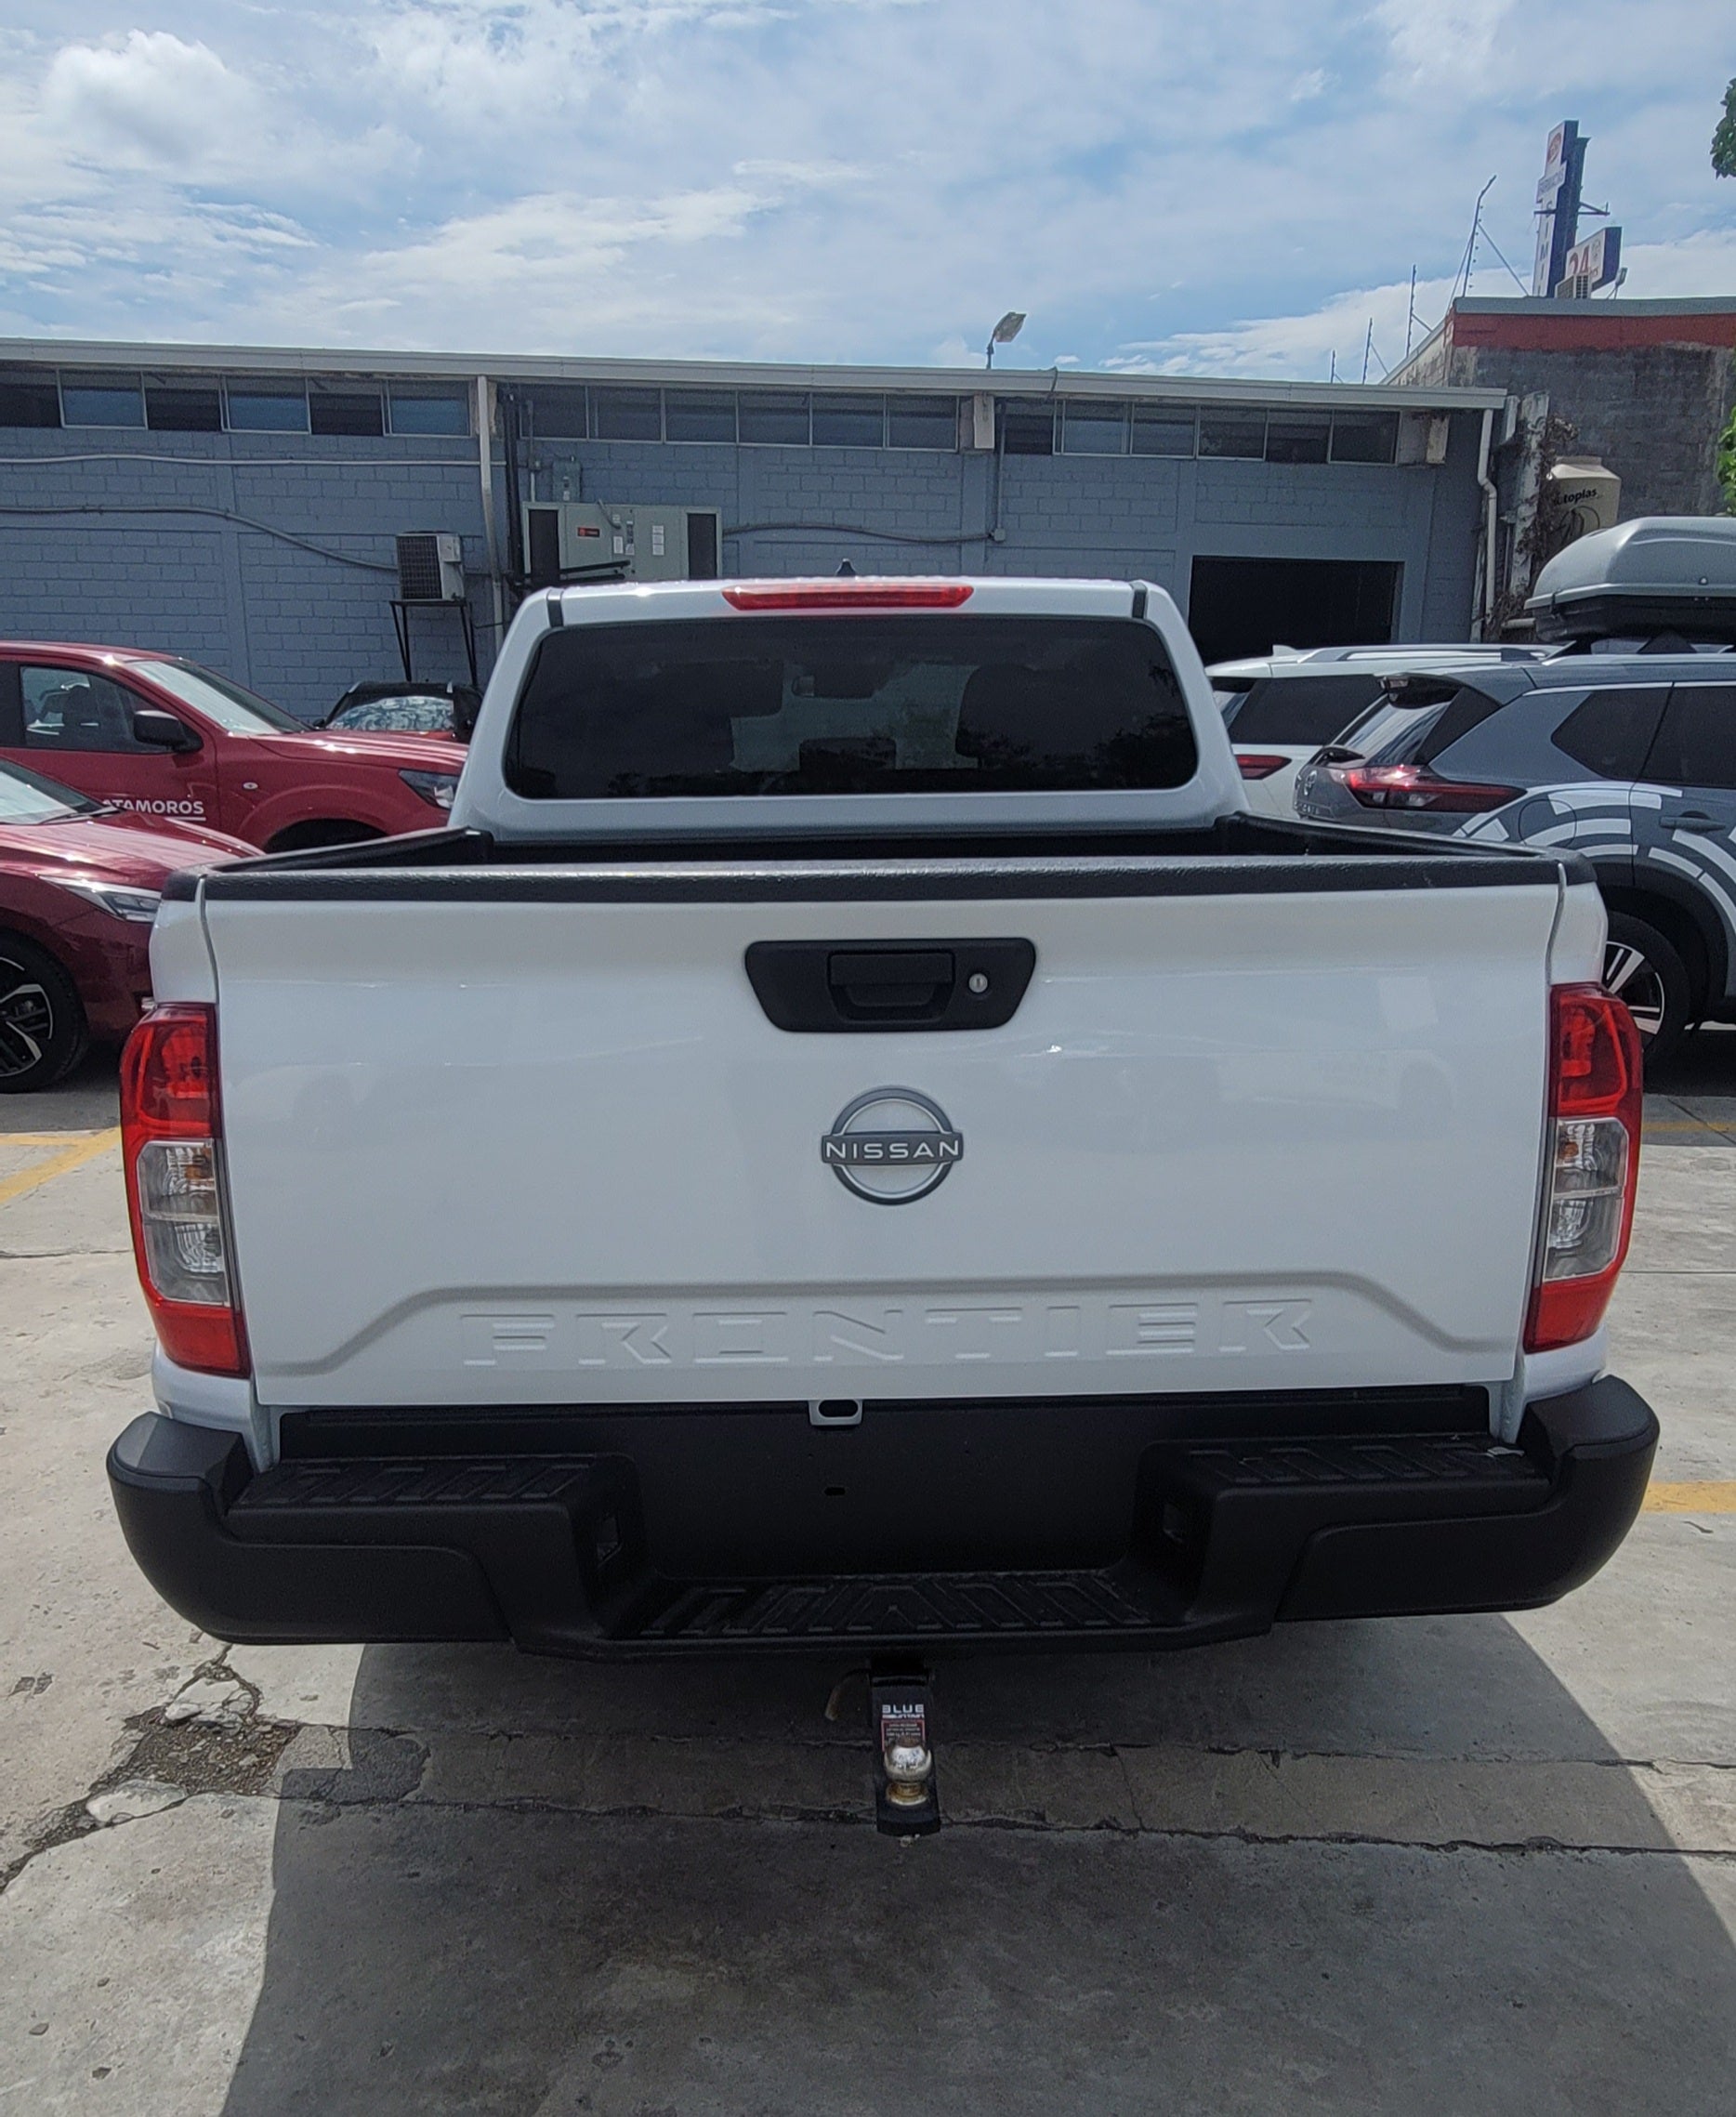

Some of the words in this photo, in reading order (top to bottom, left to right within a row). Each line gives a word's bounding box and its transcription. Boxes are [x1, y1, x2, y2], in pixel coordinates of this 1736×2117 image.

[1569, 245, 1589, 275] 24
[826, 1139, 959, 1160] NISSAN
[461, 1298, 1313, 1364] FRONTIER
[882, 1703, 925, 1714] BLUE
